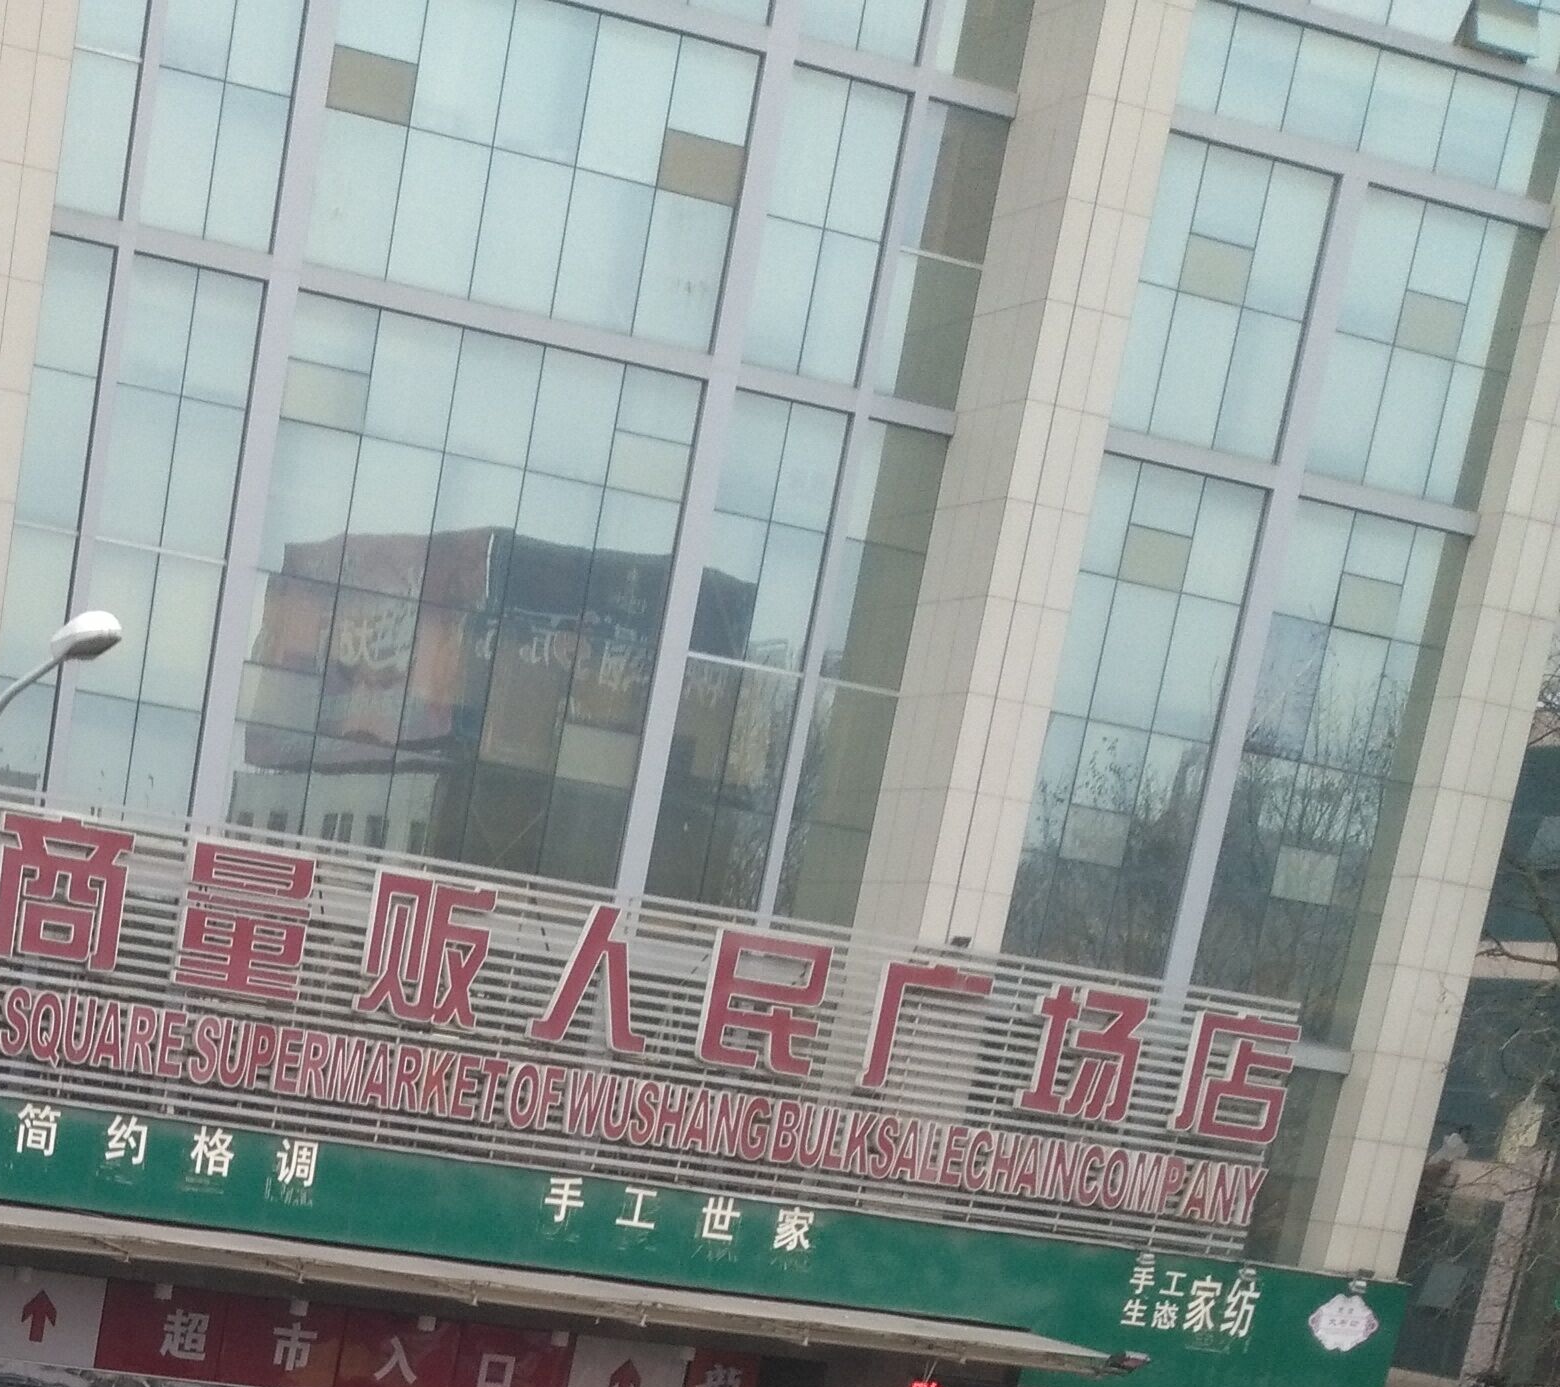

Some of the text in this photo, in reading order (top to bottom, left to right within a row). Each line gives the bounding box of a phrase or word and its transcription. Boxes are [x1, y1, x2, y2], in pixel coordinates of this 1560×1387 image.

[0, 984, 187, 1080] SQUARE
[187, 1014, 510, 1122] SUPERMARKET
[508, 1061, 567, 1131] OF
[564, 1069, 774, 1161] WUSHANG
[1077, 1142, 1268, 1227] COMPANY
[15, 1101, 320, 1188] 简约格调
[544, 1174, 817, 1253] 手工世家
[1120, 1298, 1179, 1330] 生态
[1129, 1266, 1261, 1338] 手工 家纺
